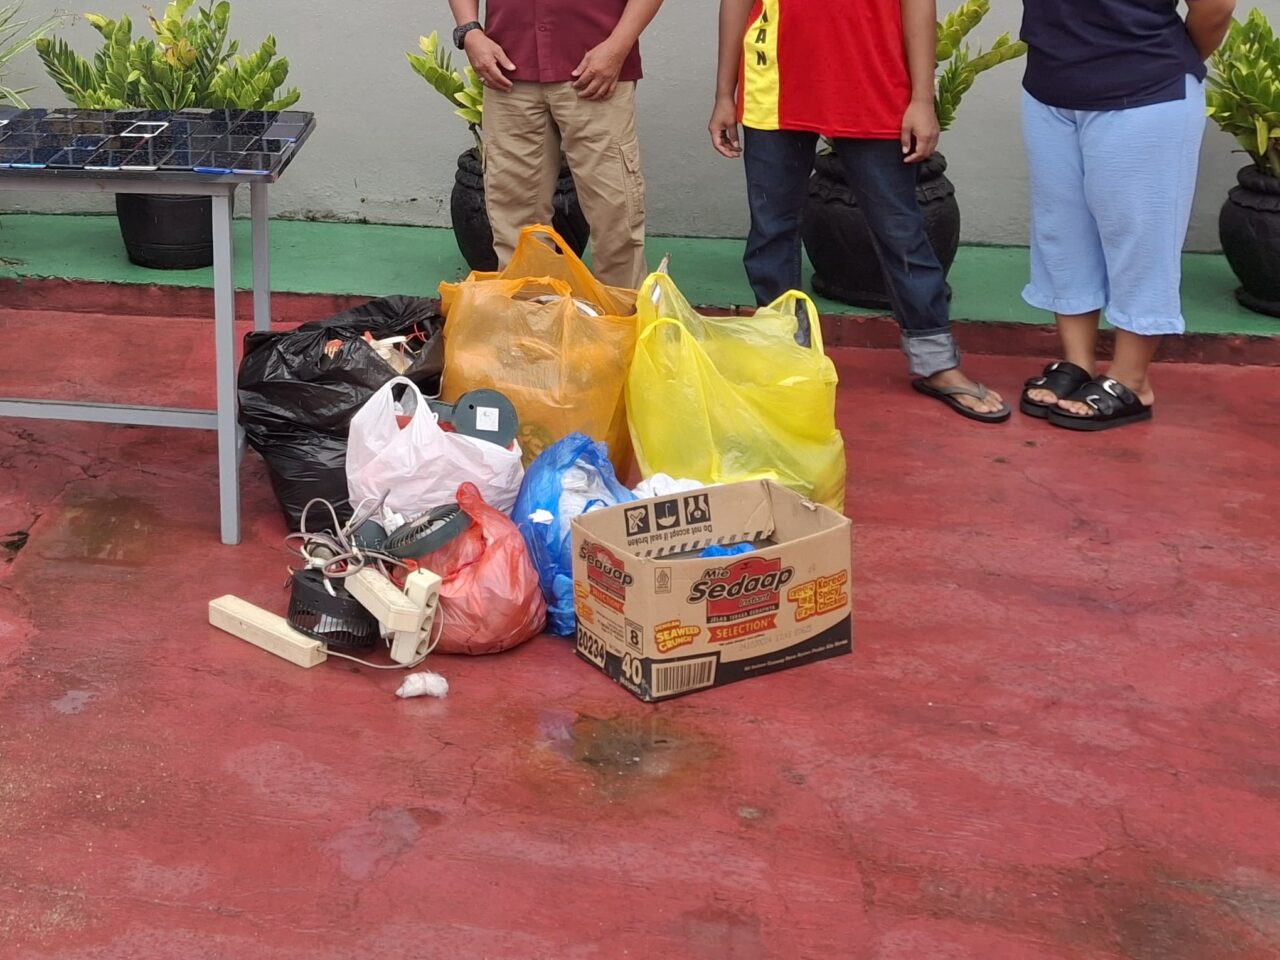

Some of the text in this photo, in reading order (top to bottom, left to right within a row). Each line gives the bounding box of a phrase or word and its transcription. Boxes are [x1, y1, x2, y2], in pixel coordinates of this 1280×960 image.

[670, 528, 690, 539] accept
[692, 527, 702, 535] not
[704, 524, 713, 533] Do
[628, 536, 648, 547] broken
[650, 533, 663, 542] seal
[579, 546, 633, 586] Sedaap
[703, 568, 730, 579] Mie
[688, 567, 793, 603] Sedaap
[817, 572, 846, 589] Korean
[630, 629, 639, 646] 8
[656, 626, 700, 643] SEAWEED
[578, 626, 605, 664] 20234
[622, 652, 642, 685] 40
